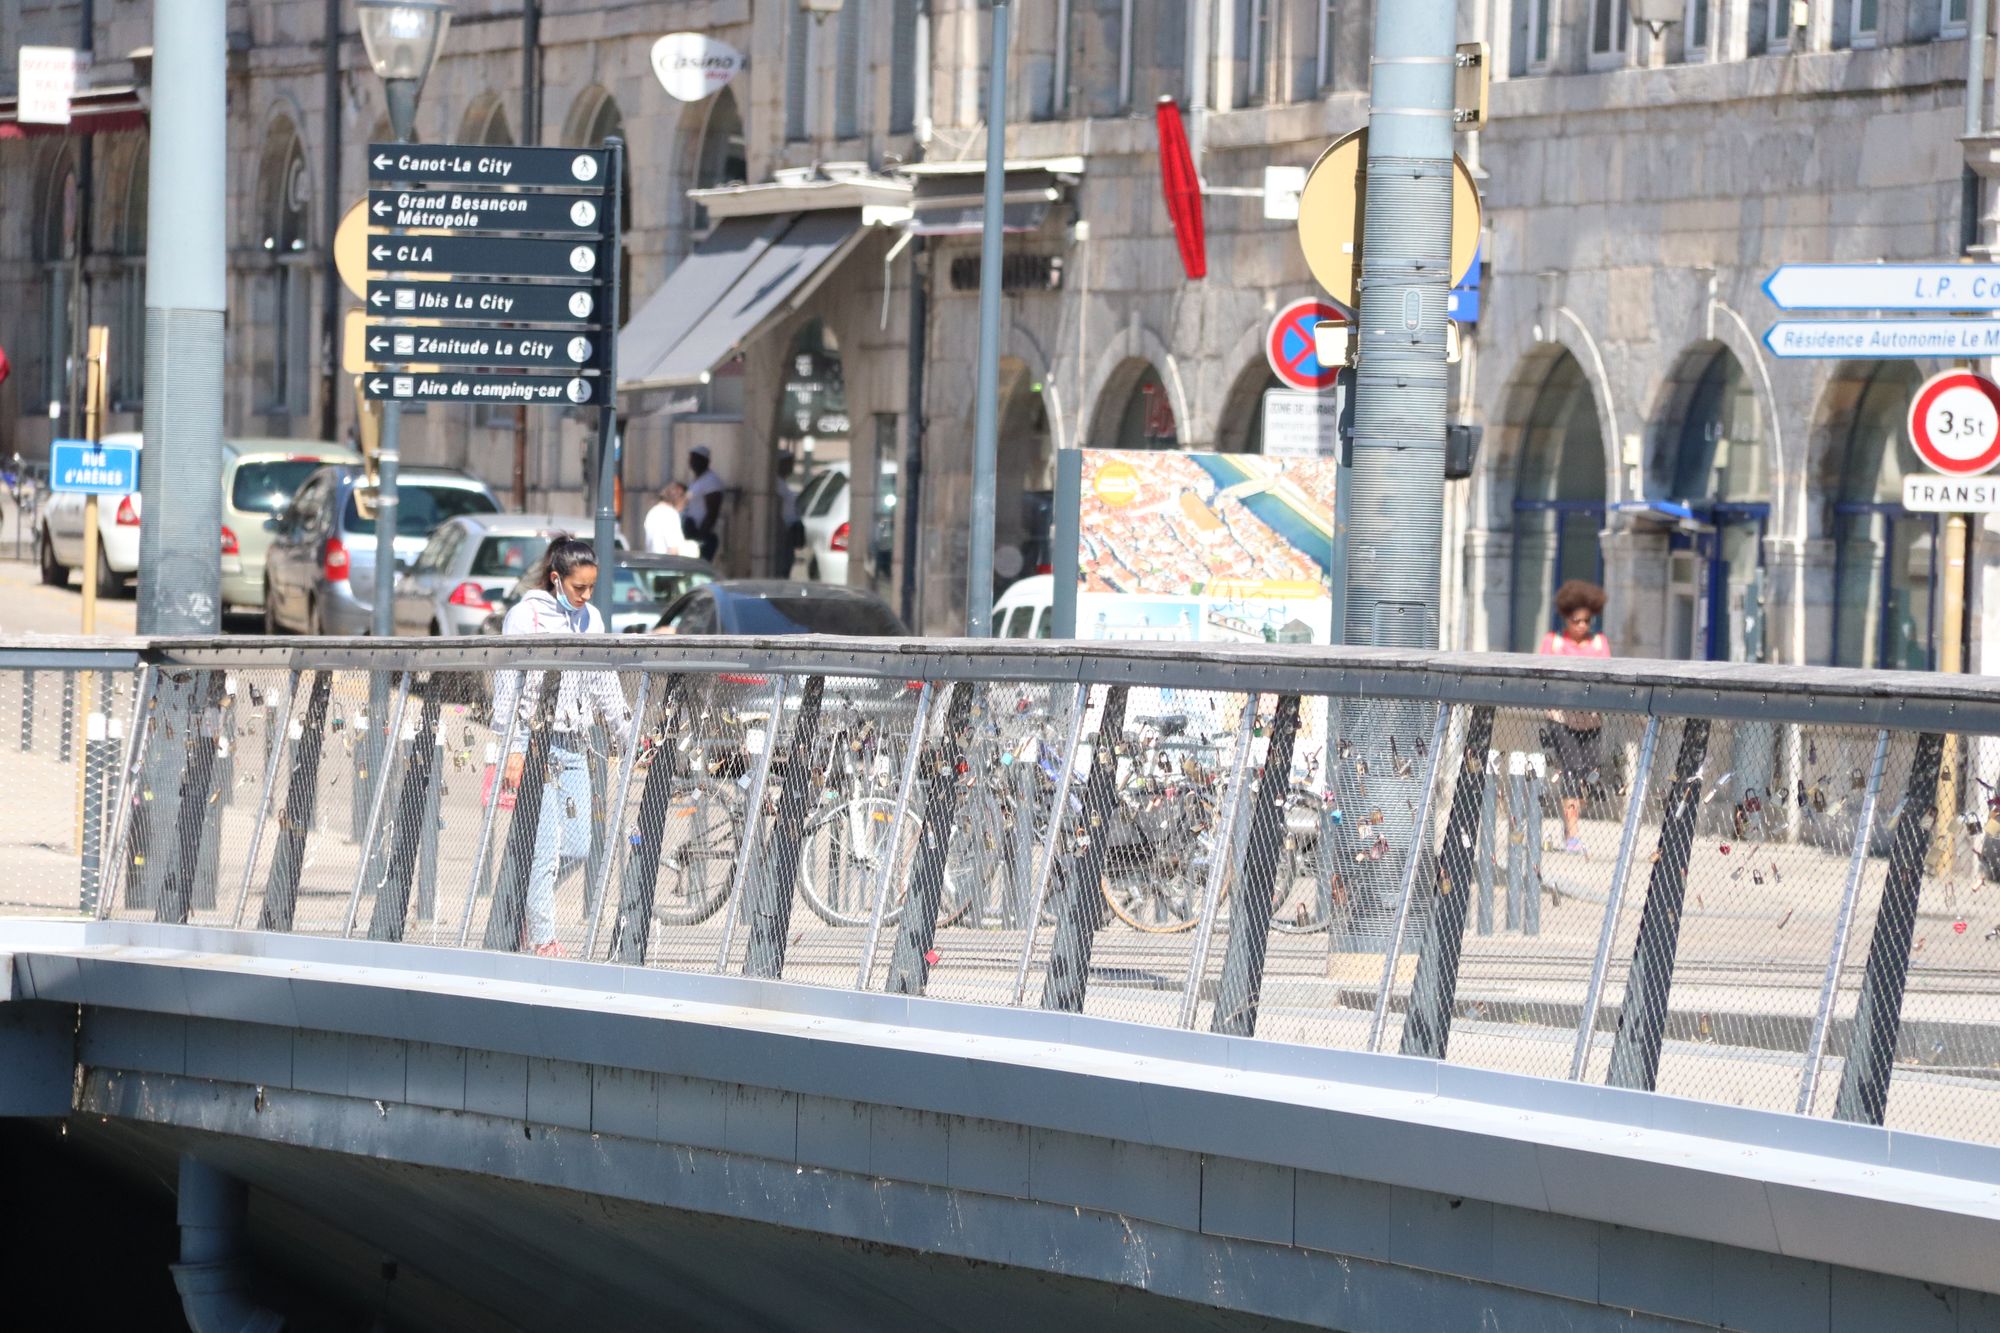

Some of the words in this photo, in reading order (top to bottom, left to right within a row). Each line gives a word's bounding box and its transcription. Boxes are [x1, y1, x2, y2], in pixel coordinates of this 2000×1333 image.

[660, 54, 735, 71] Casino
[398, 154, 471, 173] Canot-La
[478, 156, 512, 176] City
[397, 193, 445, 210] Grand
[451, 196, 528, 212] Besançon
[397, 209, 479, 228] Métropole
[1915, 277, 1956, 298] L.P.
[1973, 277, 2000, 298] Co
[419, 292, 449, 308] Ibis
[455, 294, 473, 309] La
[480, 294, 513, 312] City
[418, 337, 489, 354] Zénitude
[495, 341, 513, 355] La
[520, 341, 553, 359] City
[1784, 329, 1863, 347] Résidence
[1870, 330, 1956, 348] Autonomie
[1961, 331, 1979, 346] Le
[418, 380, 447, 395] Aire
[452, 381, 469, 396] de
[473, 382, 562, 400] camping-car
[1938, 411, 1985, 439] 3,5t
[82, 451, 106, 467] RUE
[1910, 485, 1996, 503] TRANSI
